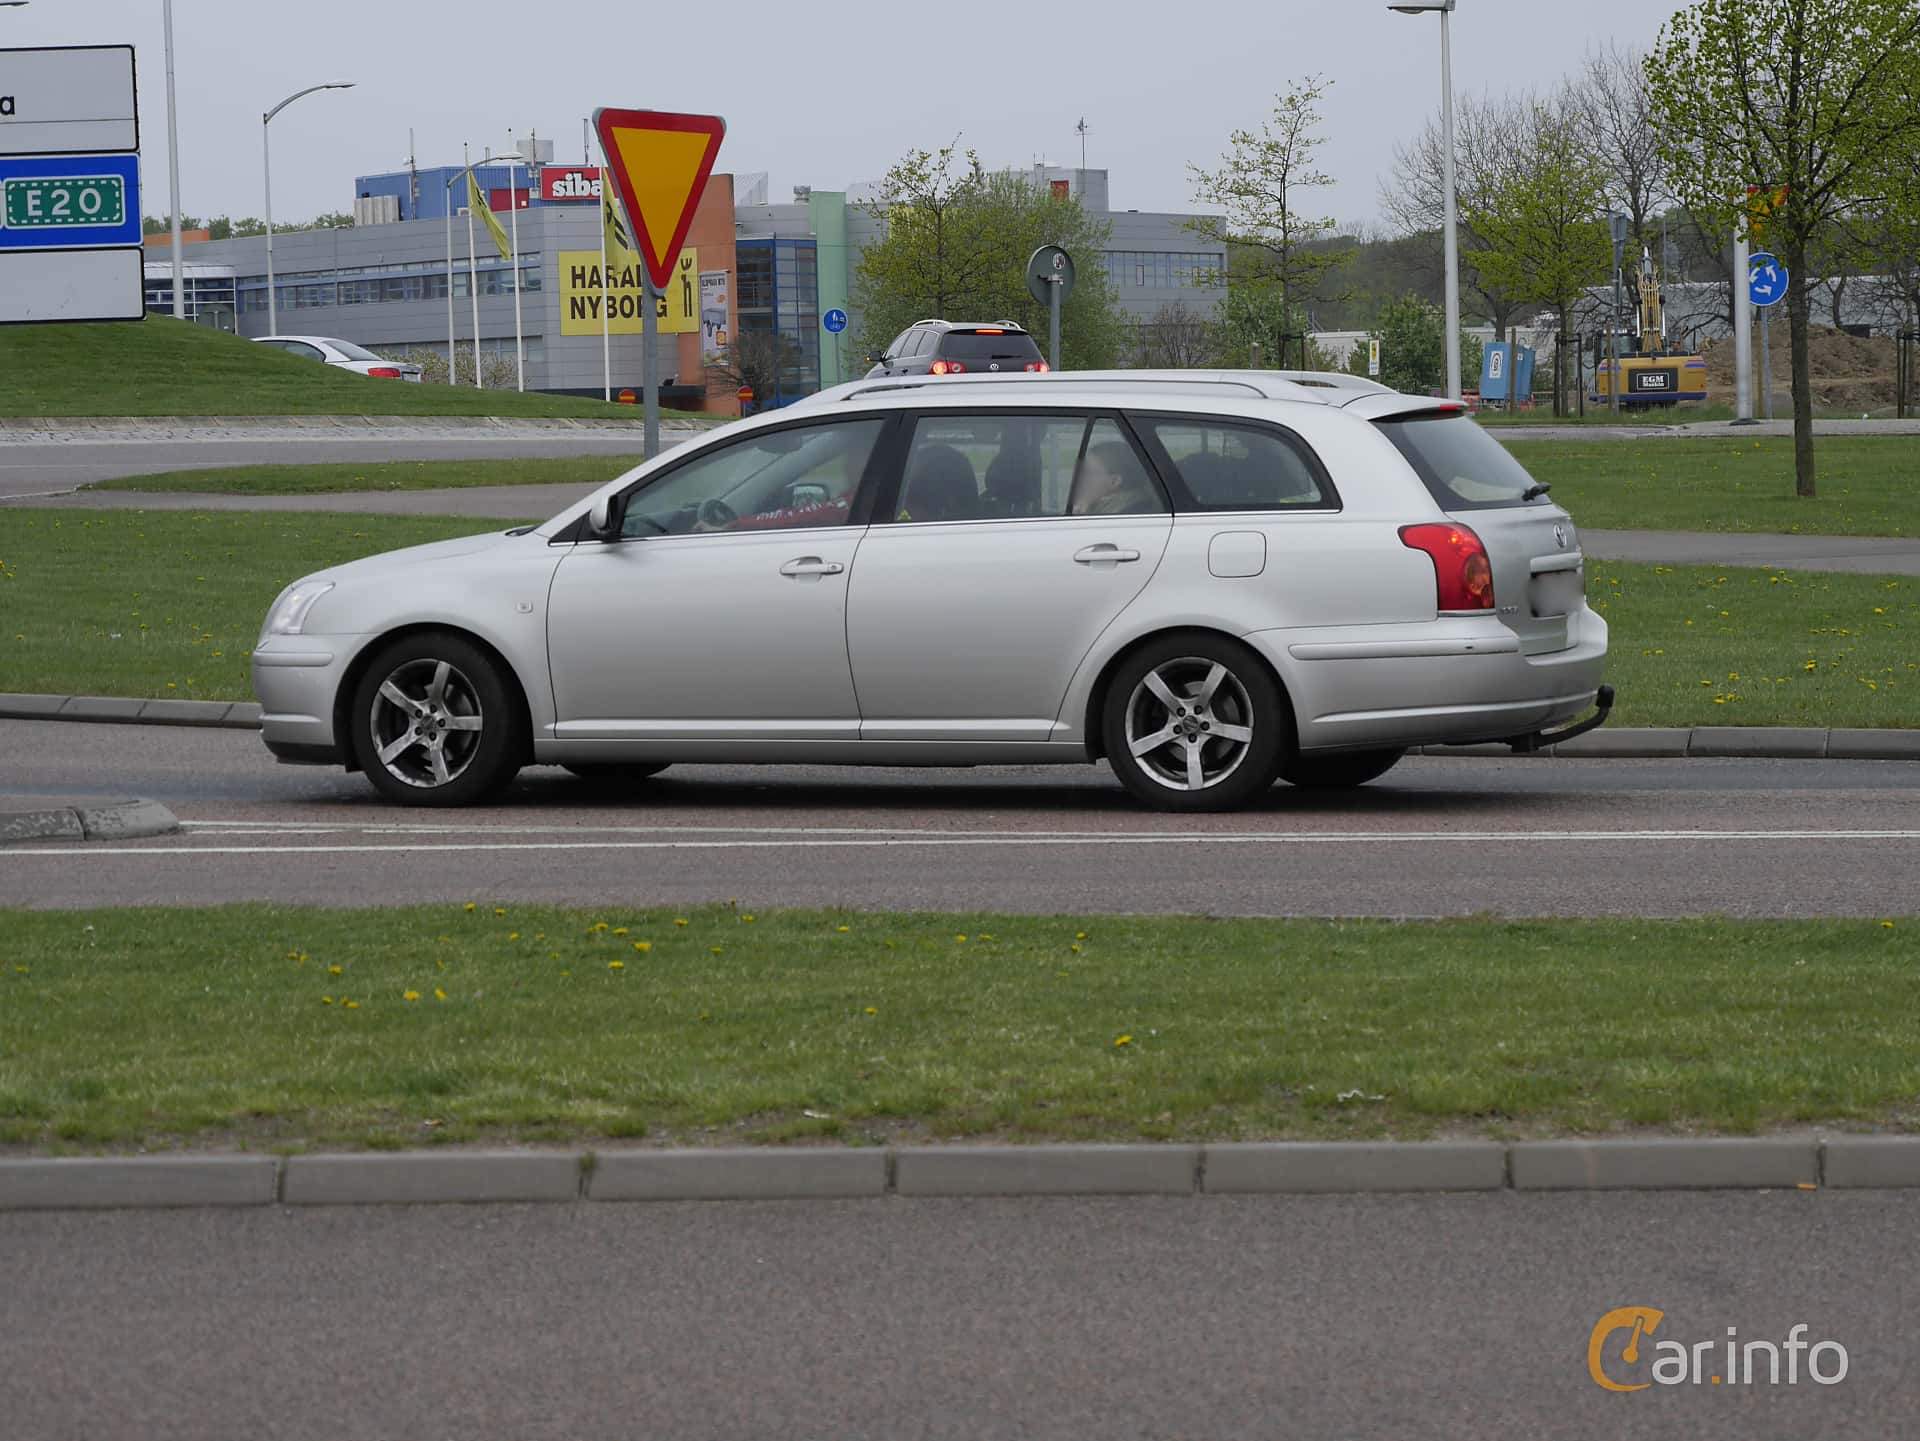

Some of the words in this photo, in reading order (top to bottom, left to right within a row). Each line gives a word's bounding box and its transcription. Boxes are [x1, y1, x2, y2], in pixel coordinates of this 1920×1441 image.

[552, 172, 602, 197] siba
[26, 187, 102, 217] E20
[571, 264, 643, 289] HARAL
[1642, 375, 1664, 383] EGM
